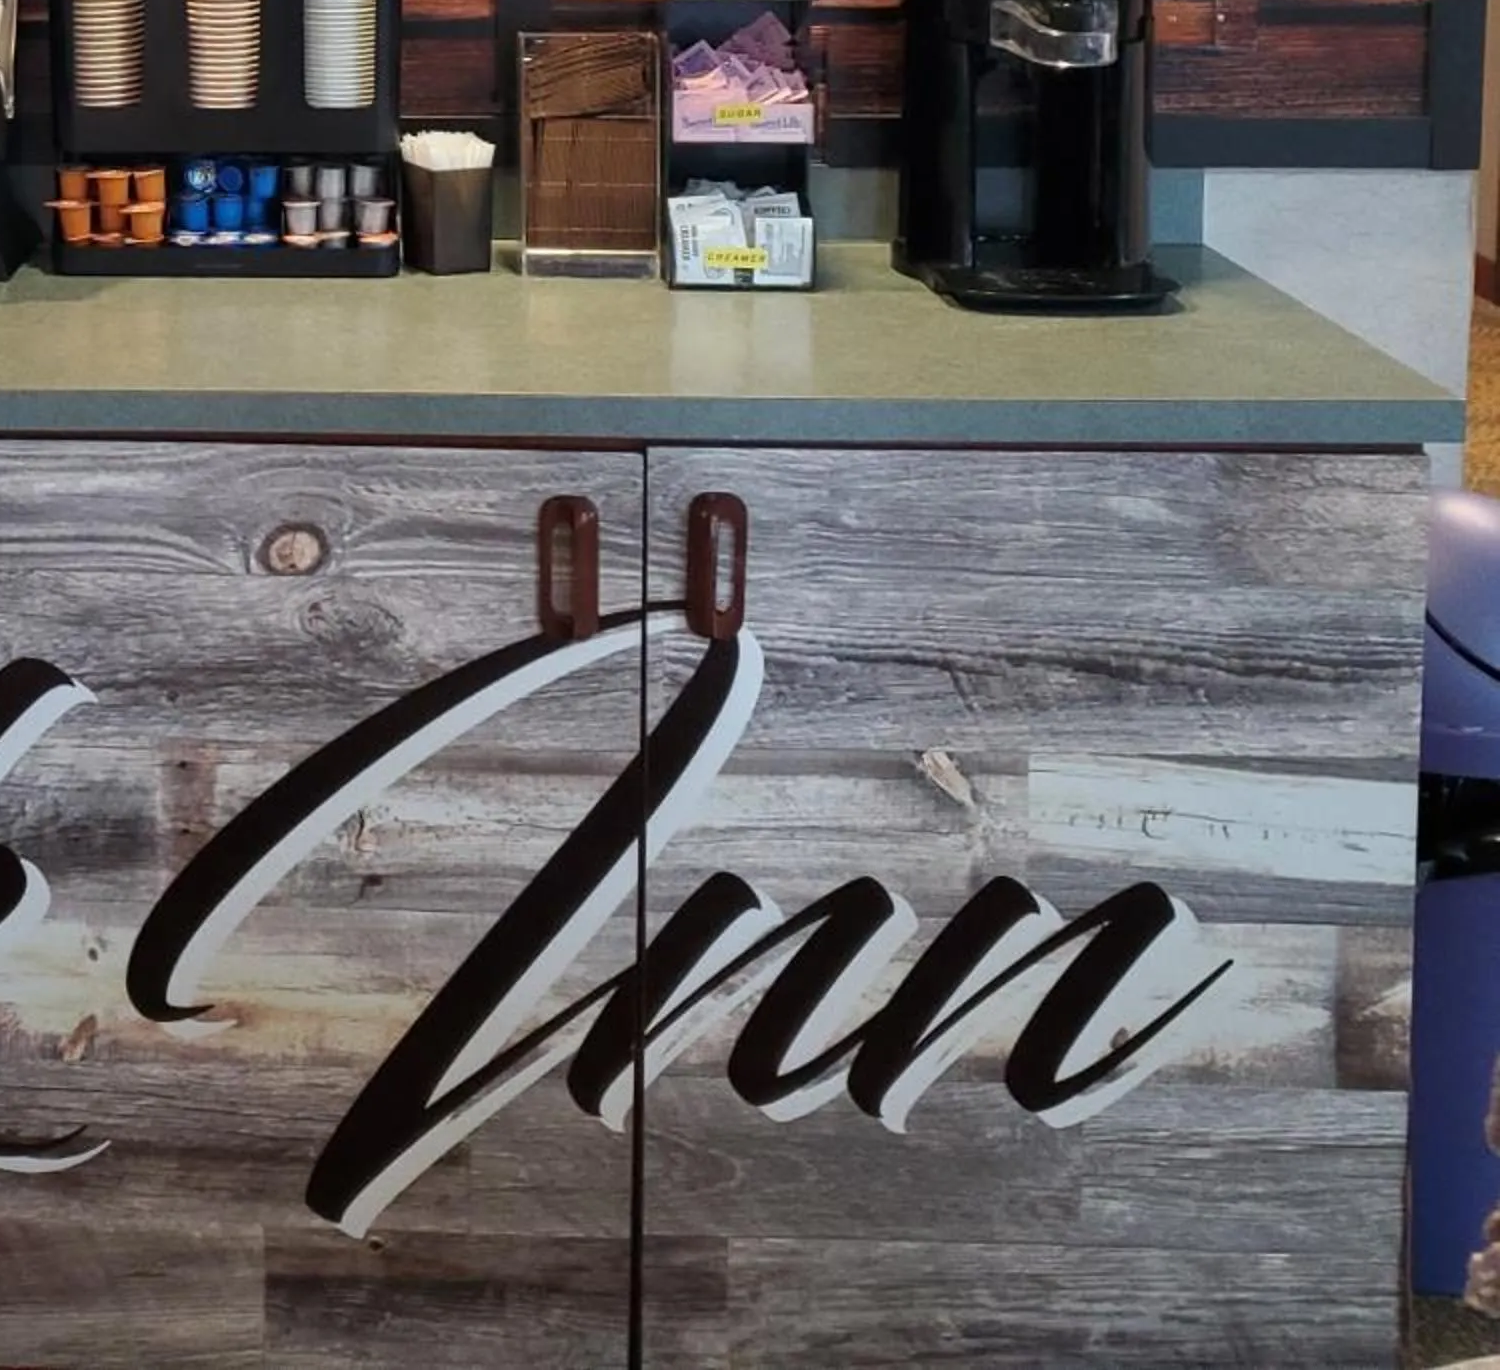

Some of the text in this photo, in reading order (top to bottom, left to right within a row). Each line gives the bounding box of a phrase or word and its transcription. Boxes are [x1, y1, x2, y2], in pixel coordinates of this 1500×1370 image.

[718, 108, 761, 120] SUGAR
[707, 252, 767, 264] CREAMER
[127, 600, 1235, 1238] Inn
